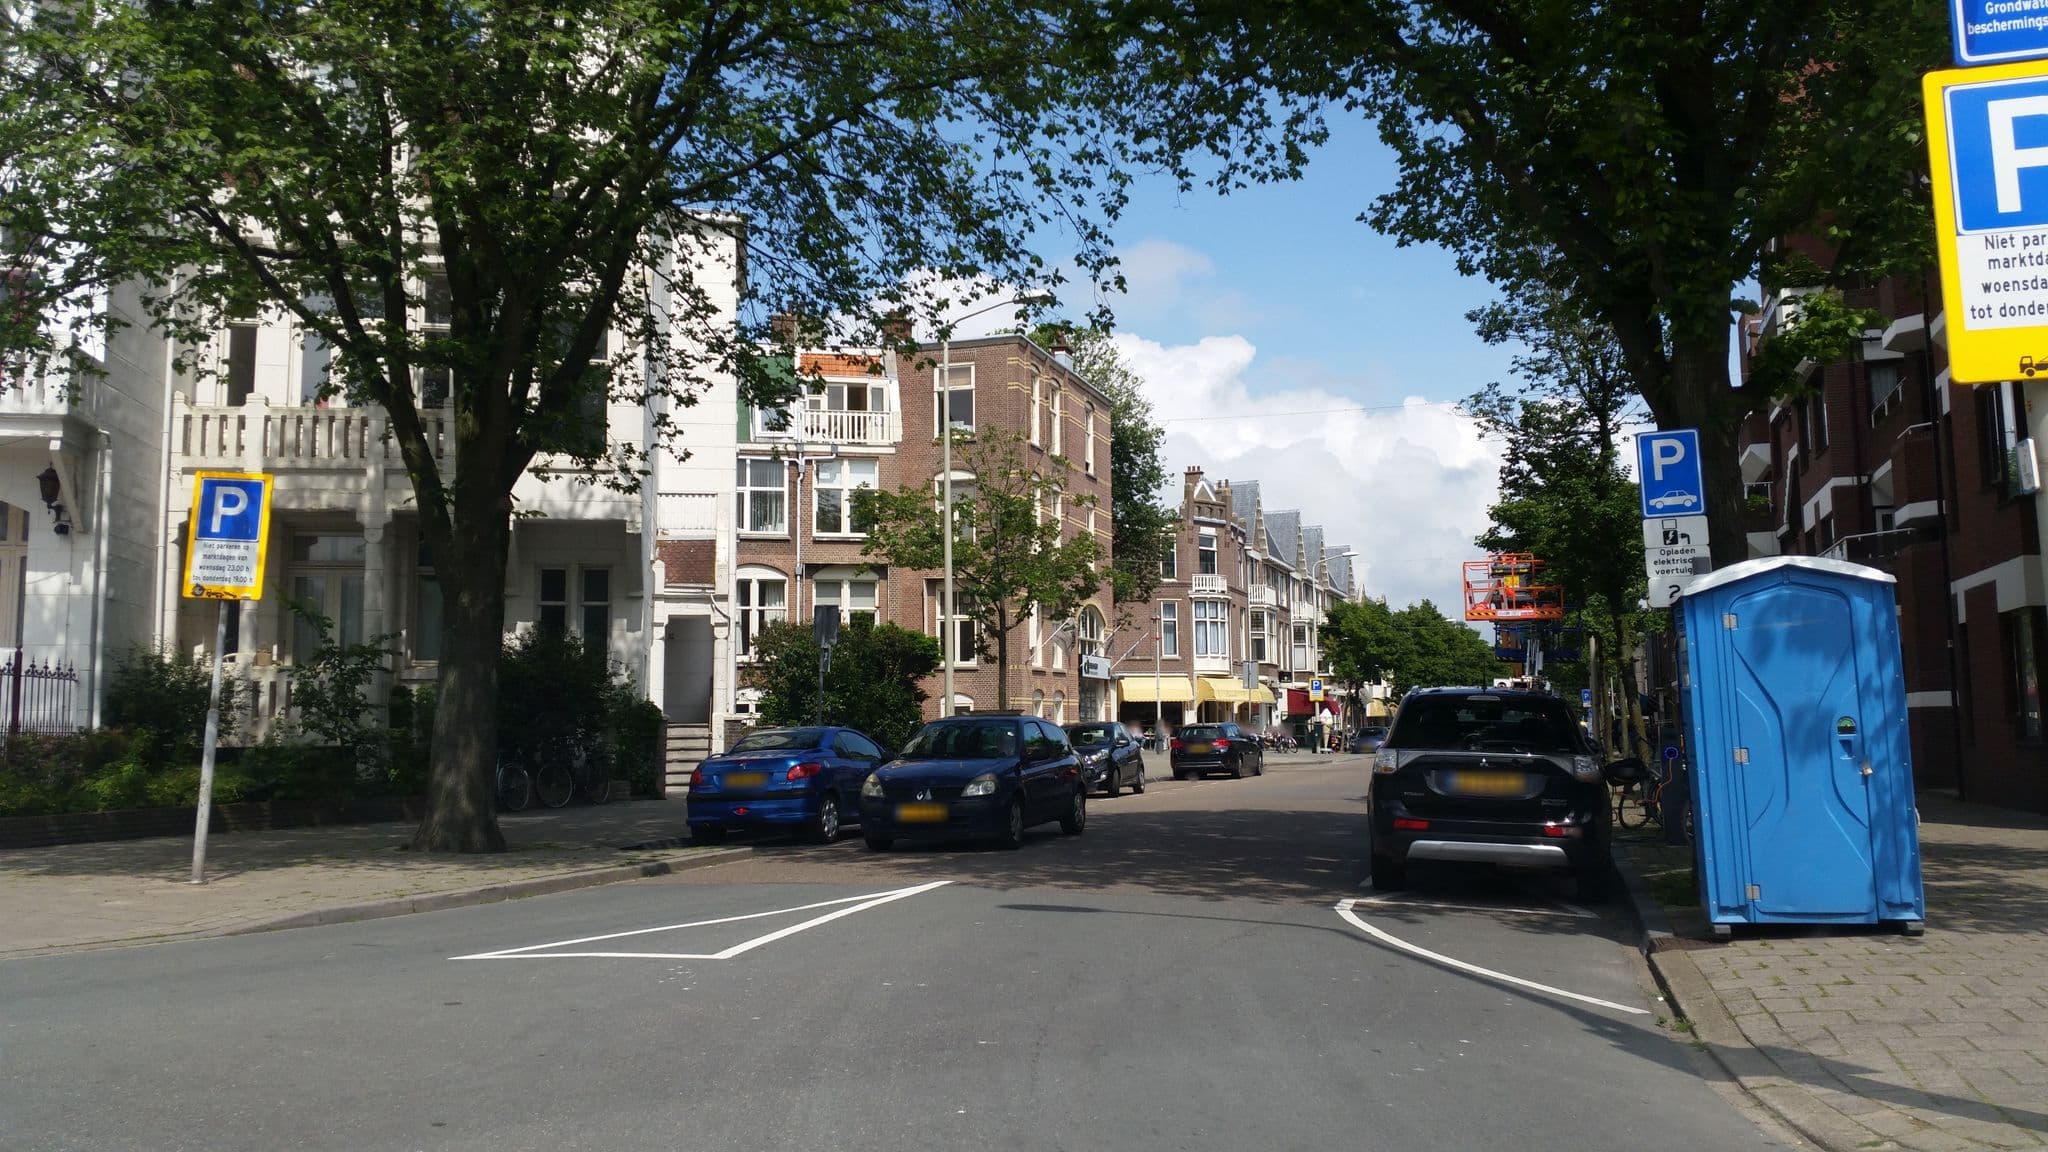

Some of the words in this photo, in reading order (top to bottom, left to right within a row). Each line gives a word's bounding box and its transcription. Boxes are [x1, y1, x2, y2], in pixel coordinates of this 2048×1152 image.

[1985, 233, 2015, 250] Niet
[1970, 304, 1993, 320] tot
[1651, 438, 1685, 481] P
[211, 486, 248, 533] P
[1660, 548, 1696, 556] Opladen
[202, 575, 231, 583] donderdag
[1313, 680, 1320, 690] P
